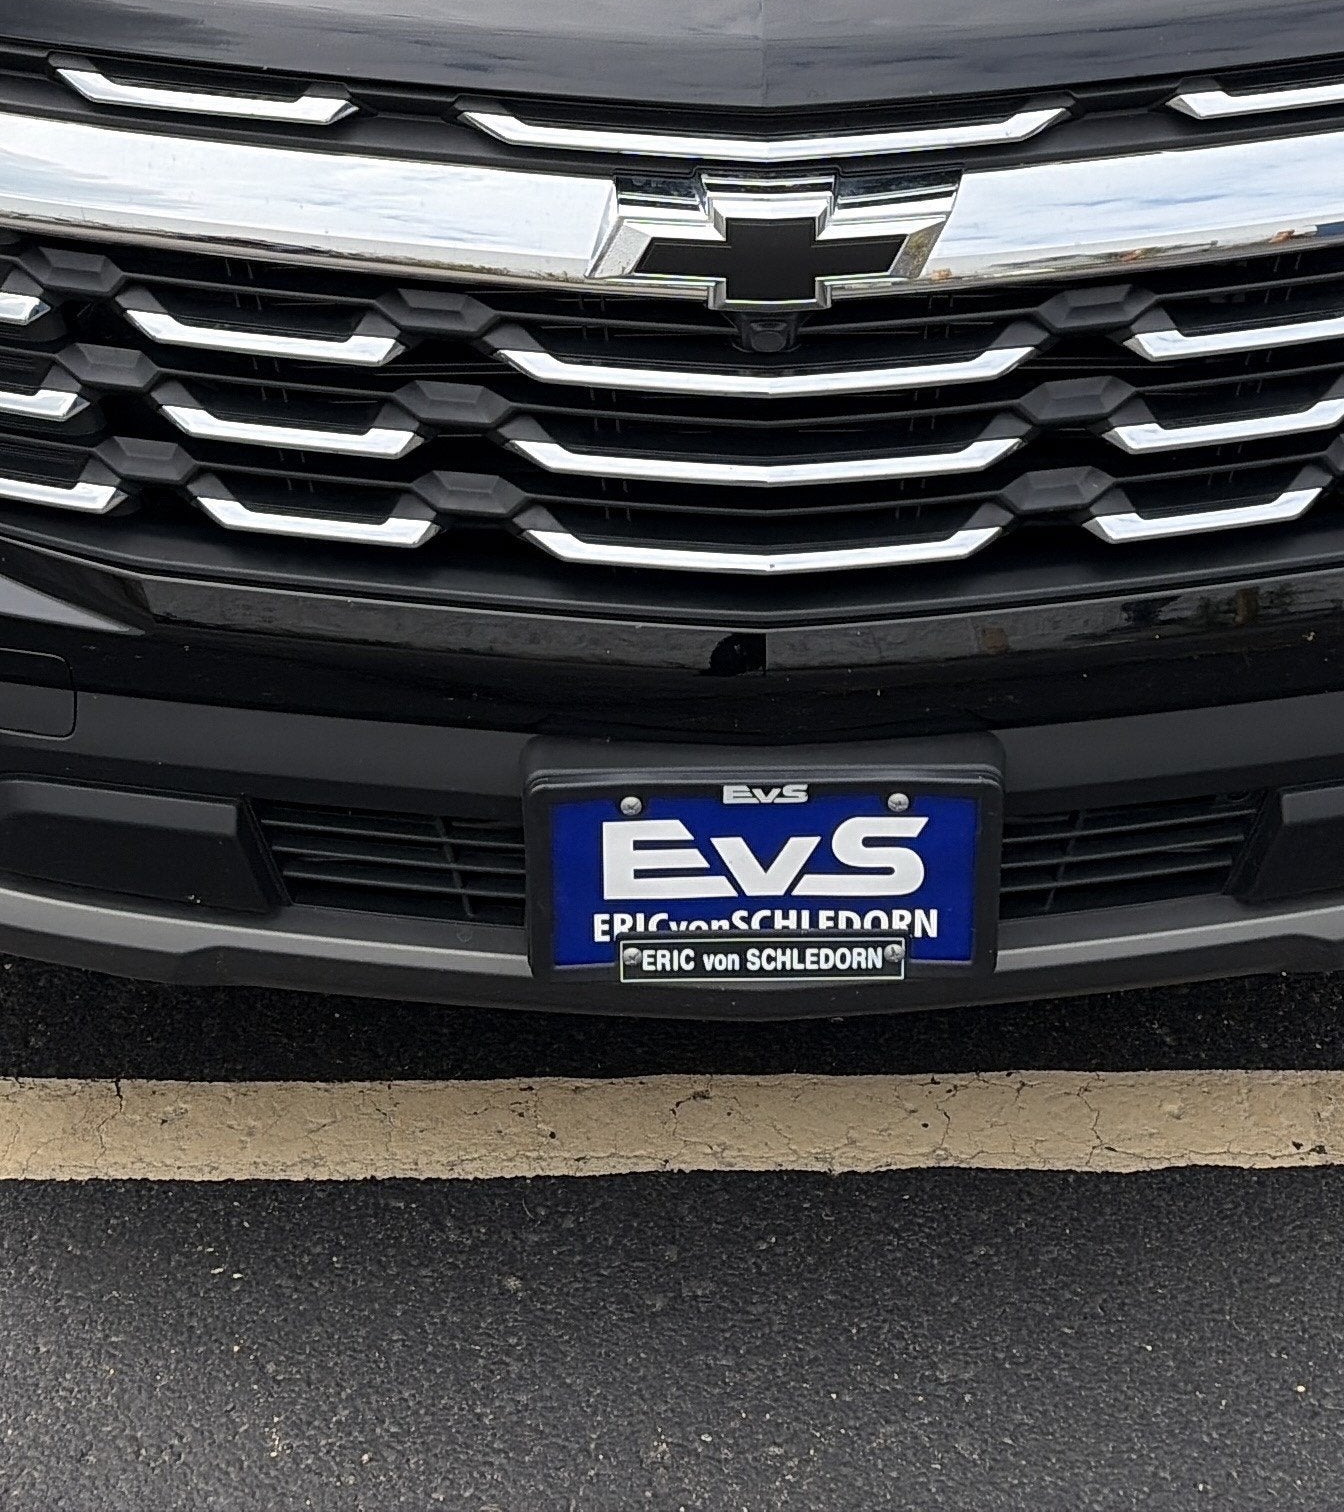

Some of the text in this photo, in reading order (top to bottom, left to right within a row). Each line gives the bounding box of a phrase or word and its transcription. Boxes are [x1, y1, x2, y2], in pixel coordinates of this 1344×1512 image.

[642, 947, 883, 971] ERIC von SCHLEDORN
